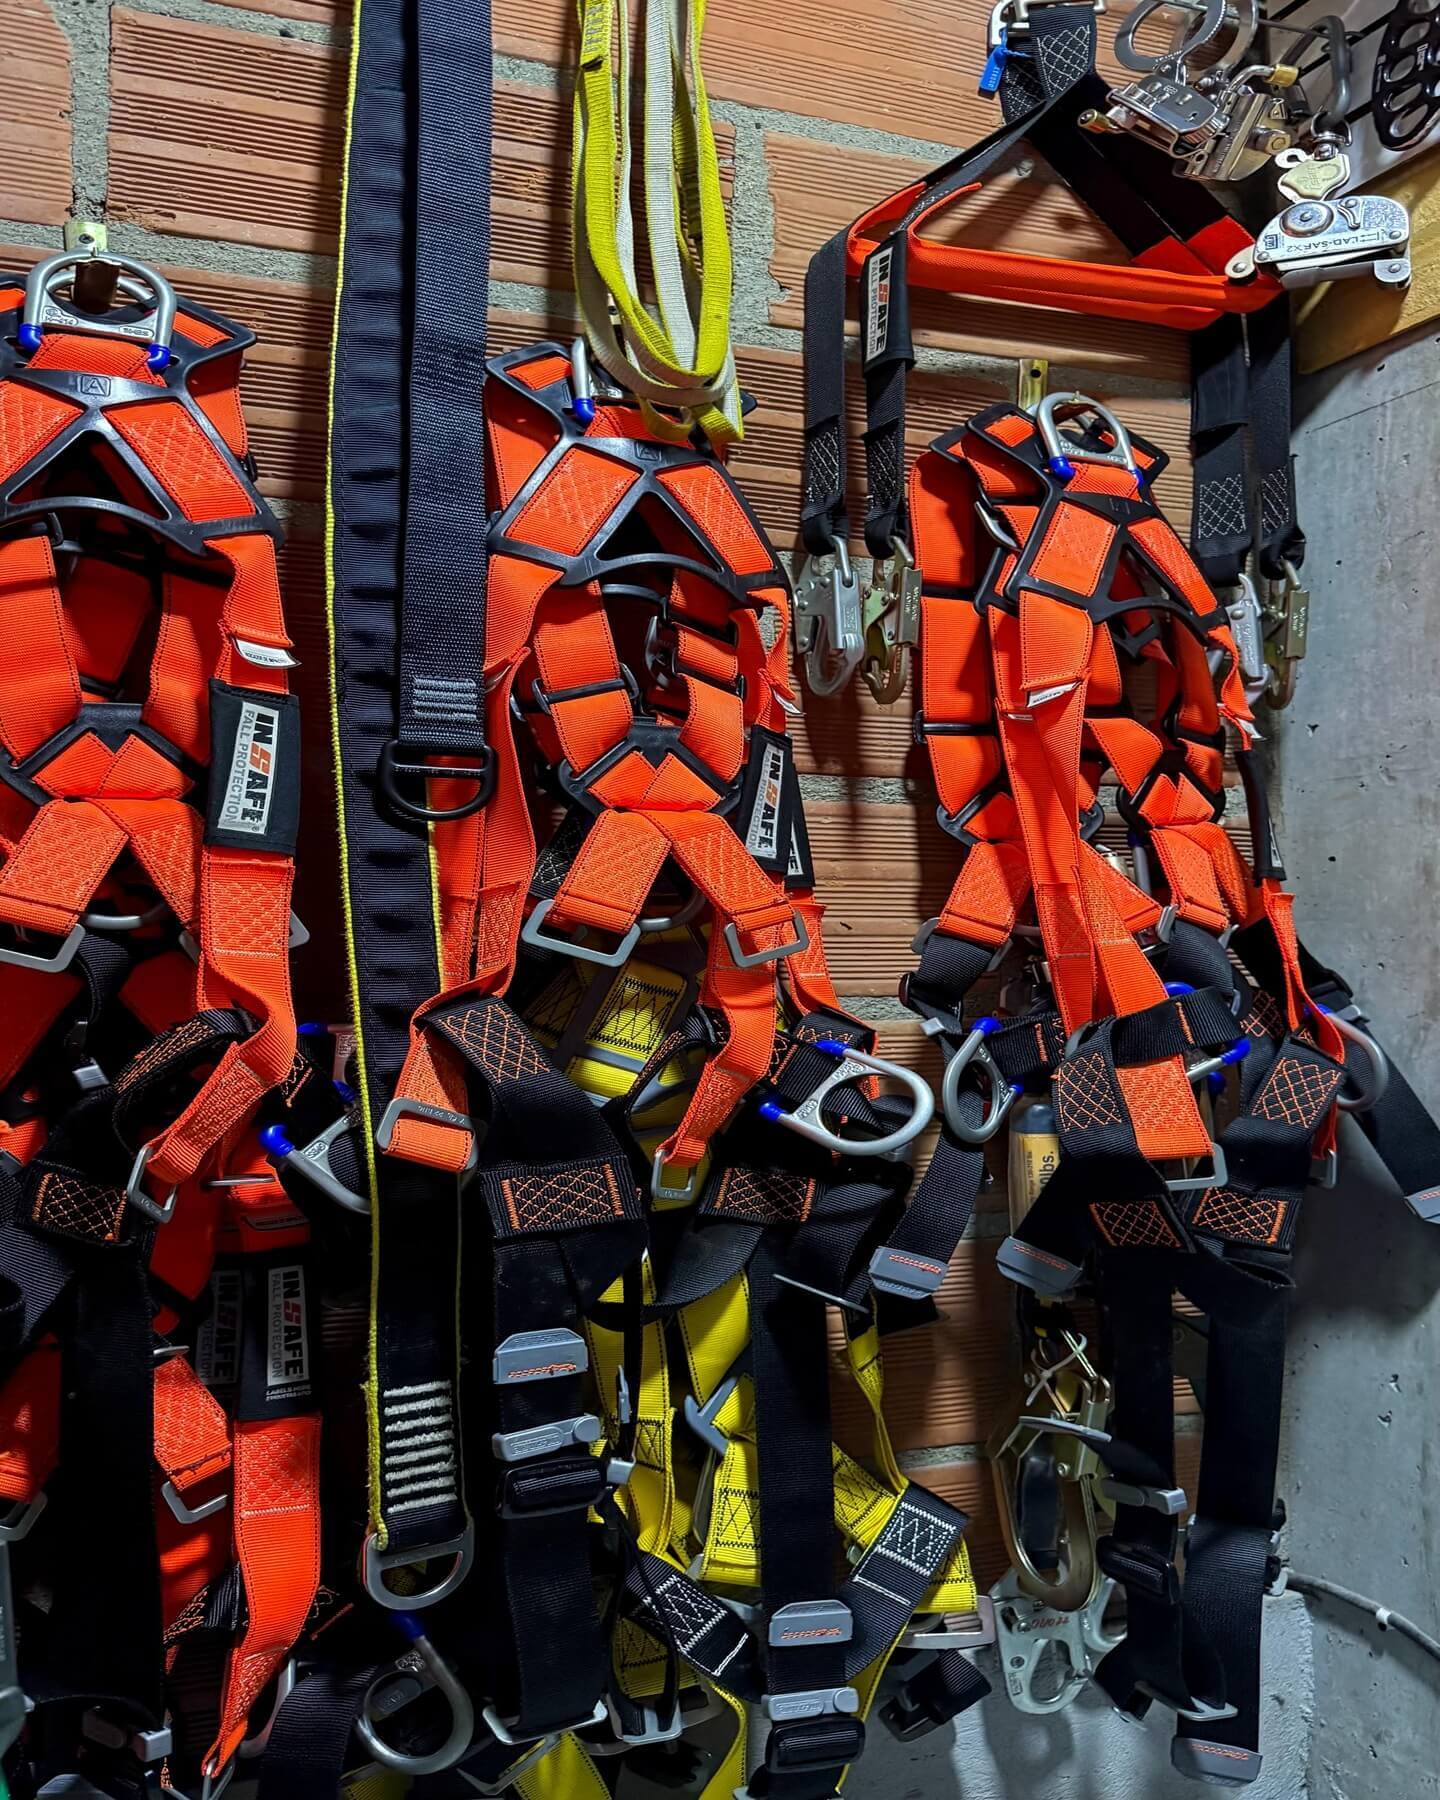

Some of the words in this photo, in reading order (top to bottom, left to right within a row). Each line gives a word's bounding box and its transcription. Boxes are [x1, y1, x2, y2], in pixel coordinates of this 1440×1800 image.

[875, 253, 890, 352] INSAFE
[239, 709, 256, 743] FALL
[240, 711, 275, 823] INSAFE
[224, 743, 249, 827] PROTECTION
[757, 752, 781, 849] INSAFE
[271, 1273, 282, 1302] FALL
[282, 1270, 304, 1377] INSAFE
[271, 1304, 282, 1379] PROTECTION
